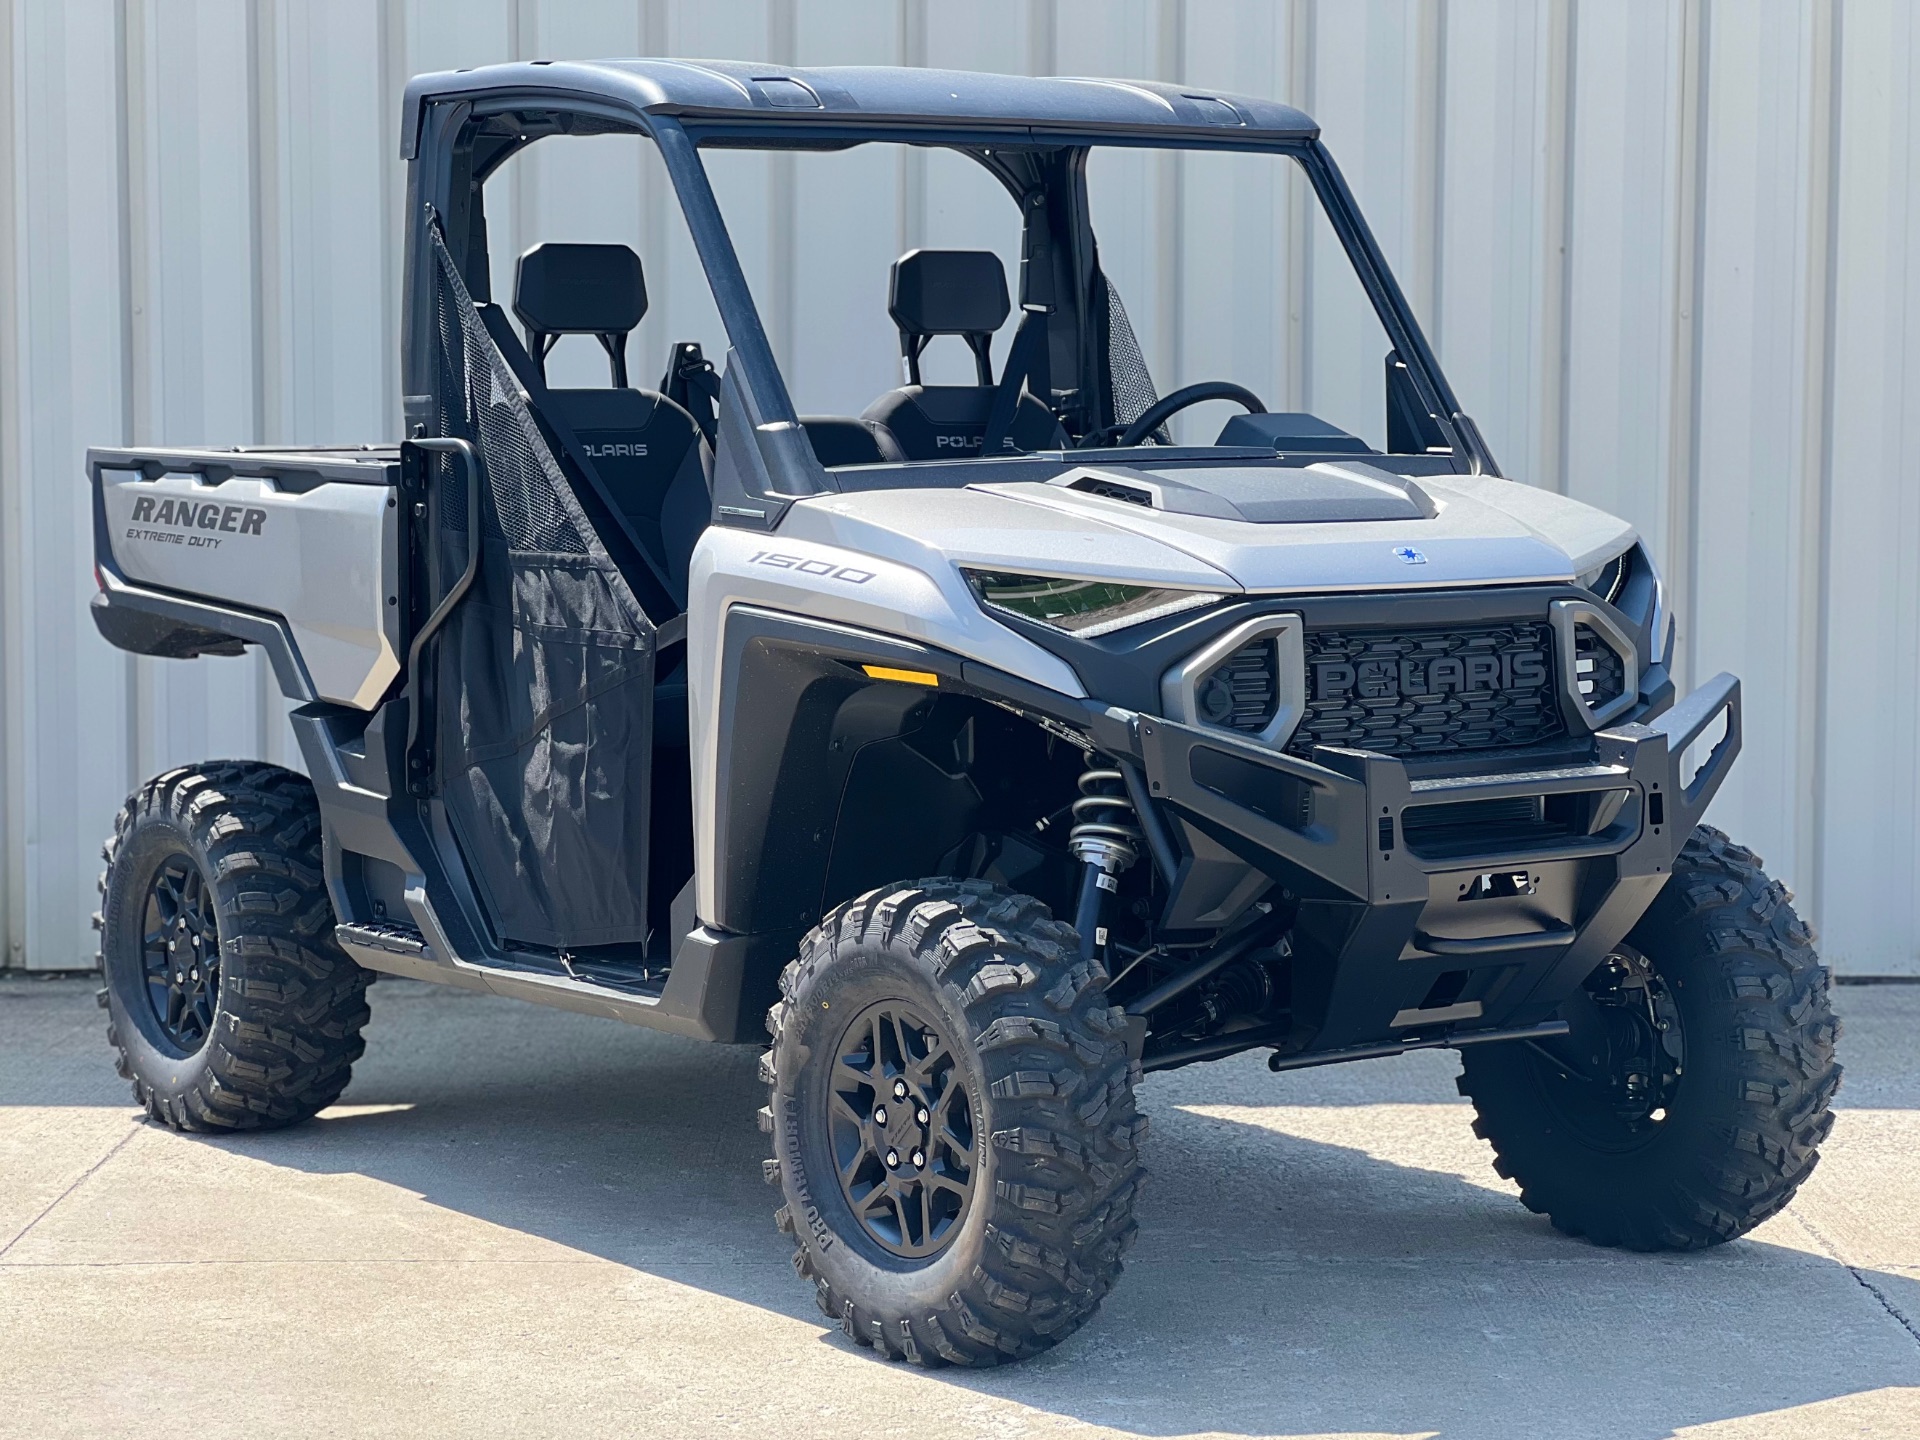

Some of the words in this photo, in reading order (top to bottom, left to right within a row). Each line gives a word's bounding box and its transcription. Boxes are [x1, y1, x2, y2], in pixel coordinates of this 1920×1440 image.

[936, 436, 1014, 448] POLAS
[131, 496, 267, 536] RANGER
[126, 528, 185, 545] EXTREME
[187, 536, 223, 549] DUTY
[747, 551, 877, 584] 1500
[1317, 652, 1546, 700] POLARIS
[785, 1118, 812, 1205] ARMOR
[805, 1205, 834, 1254] PRO
